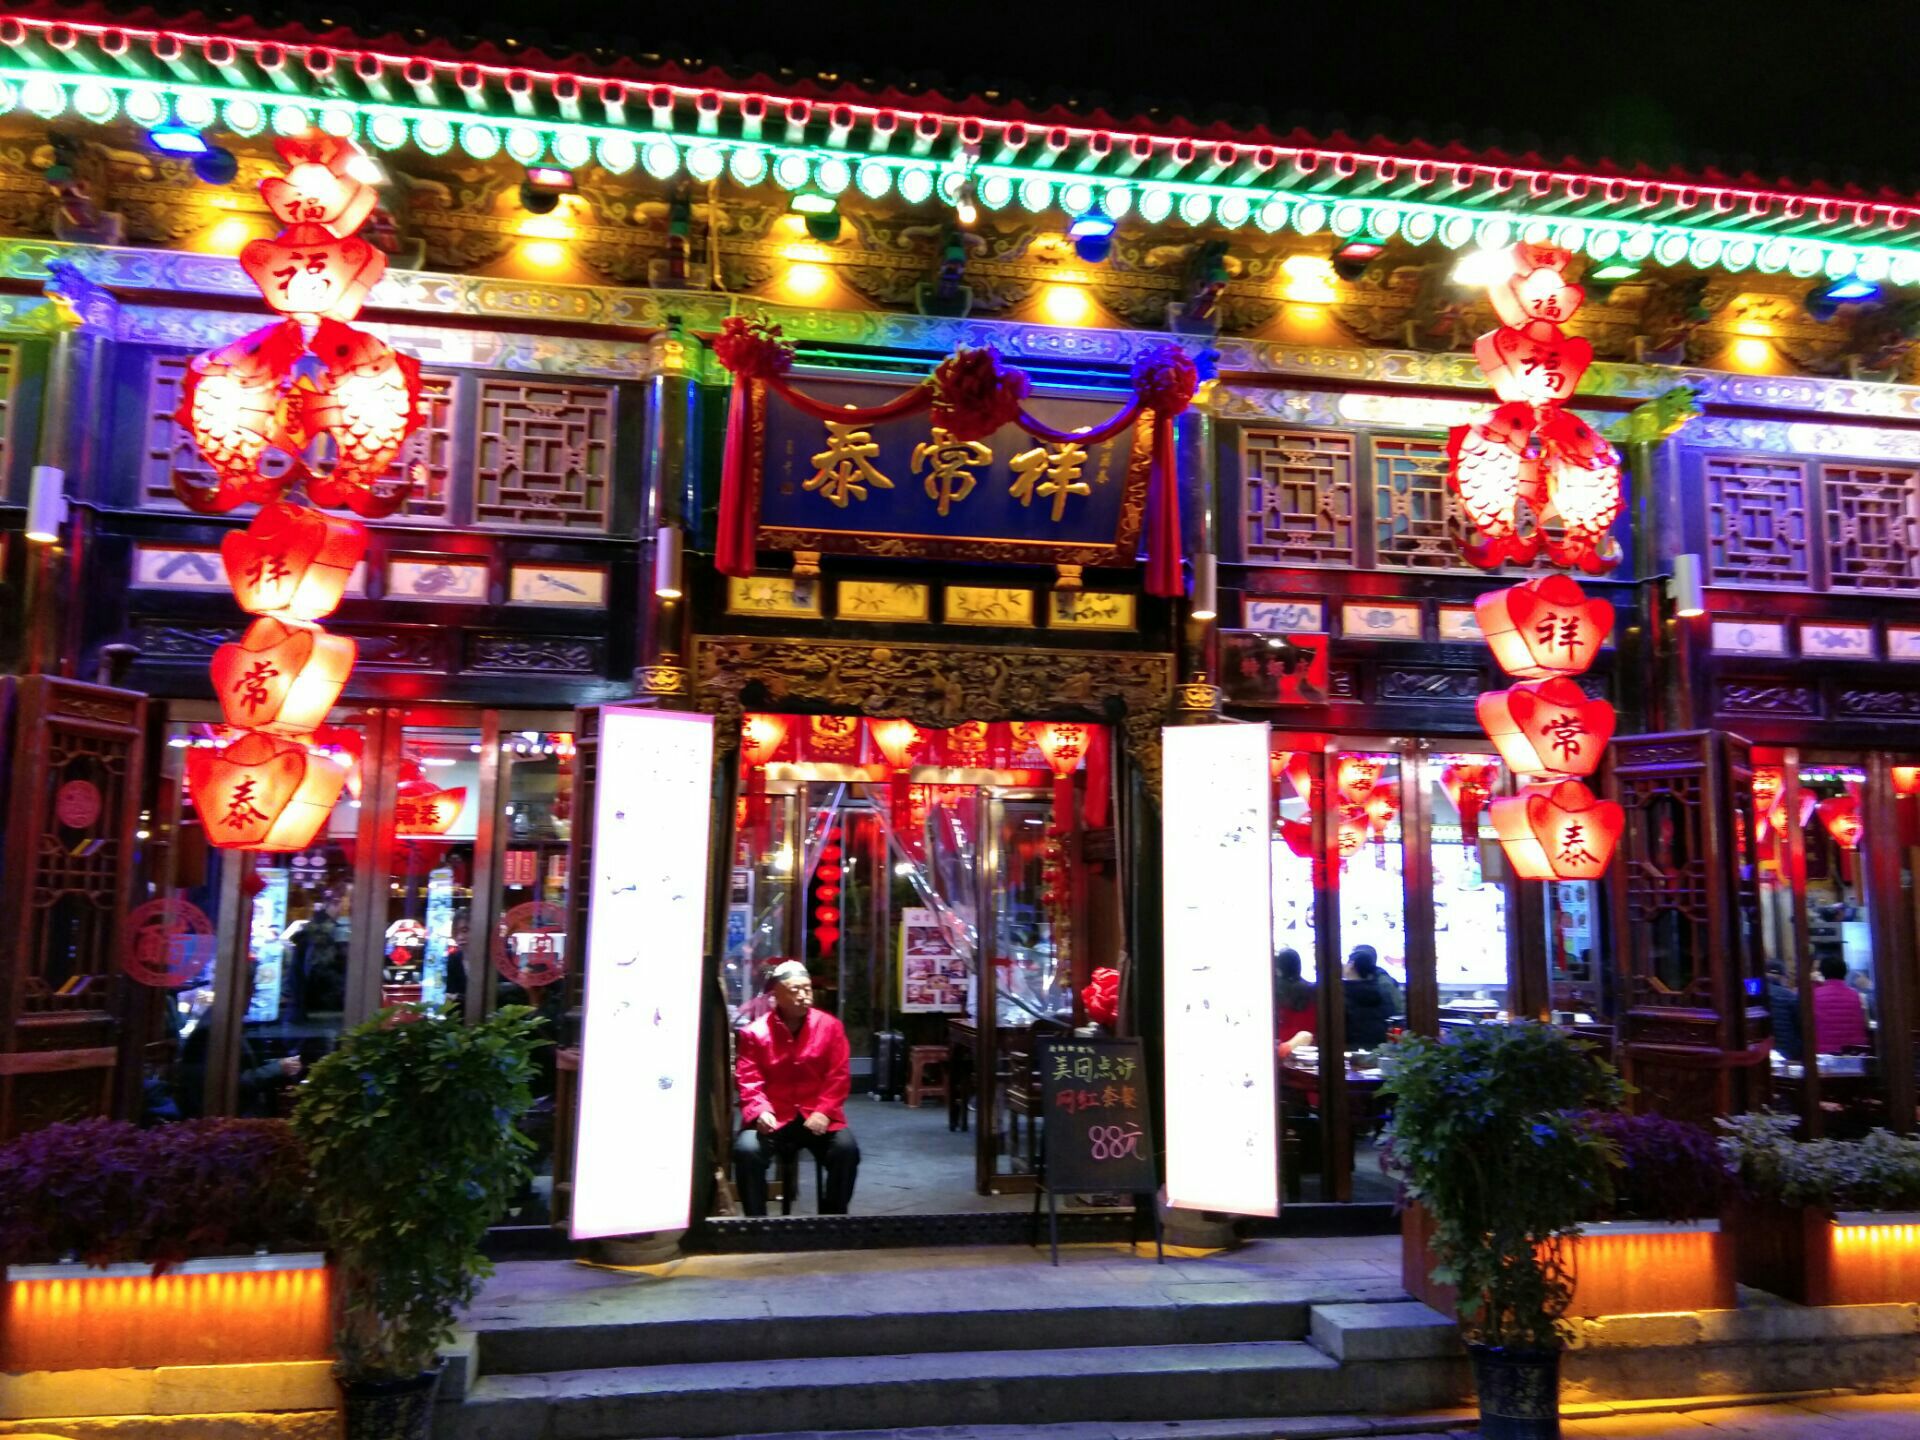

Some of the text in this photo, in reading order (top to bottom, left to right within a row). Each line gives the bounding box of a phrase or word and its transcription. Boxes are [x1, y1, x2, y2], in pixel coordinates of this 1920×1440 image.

[1535, 611, 1585, 662] 祥
[232, 659, 279, 715] 常
[1541, 713, 1592, 762] 常
[218, 774, 270, 829] 泰
[1555, 820, 1601, 866] 泰
[1088, 1121, 1147, 1161] 88元
